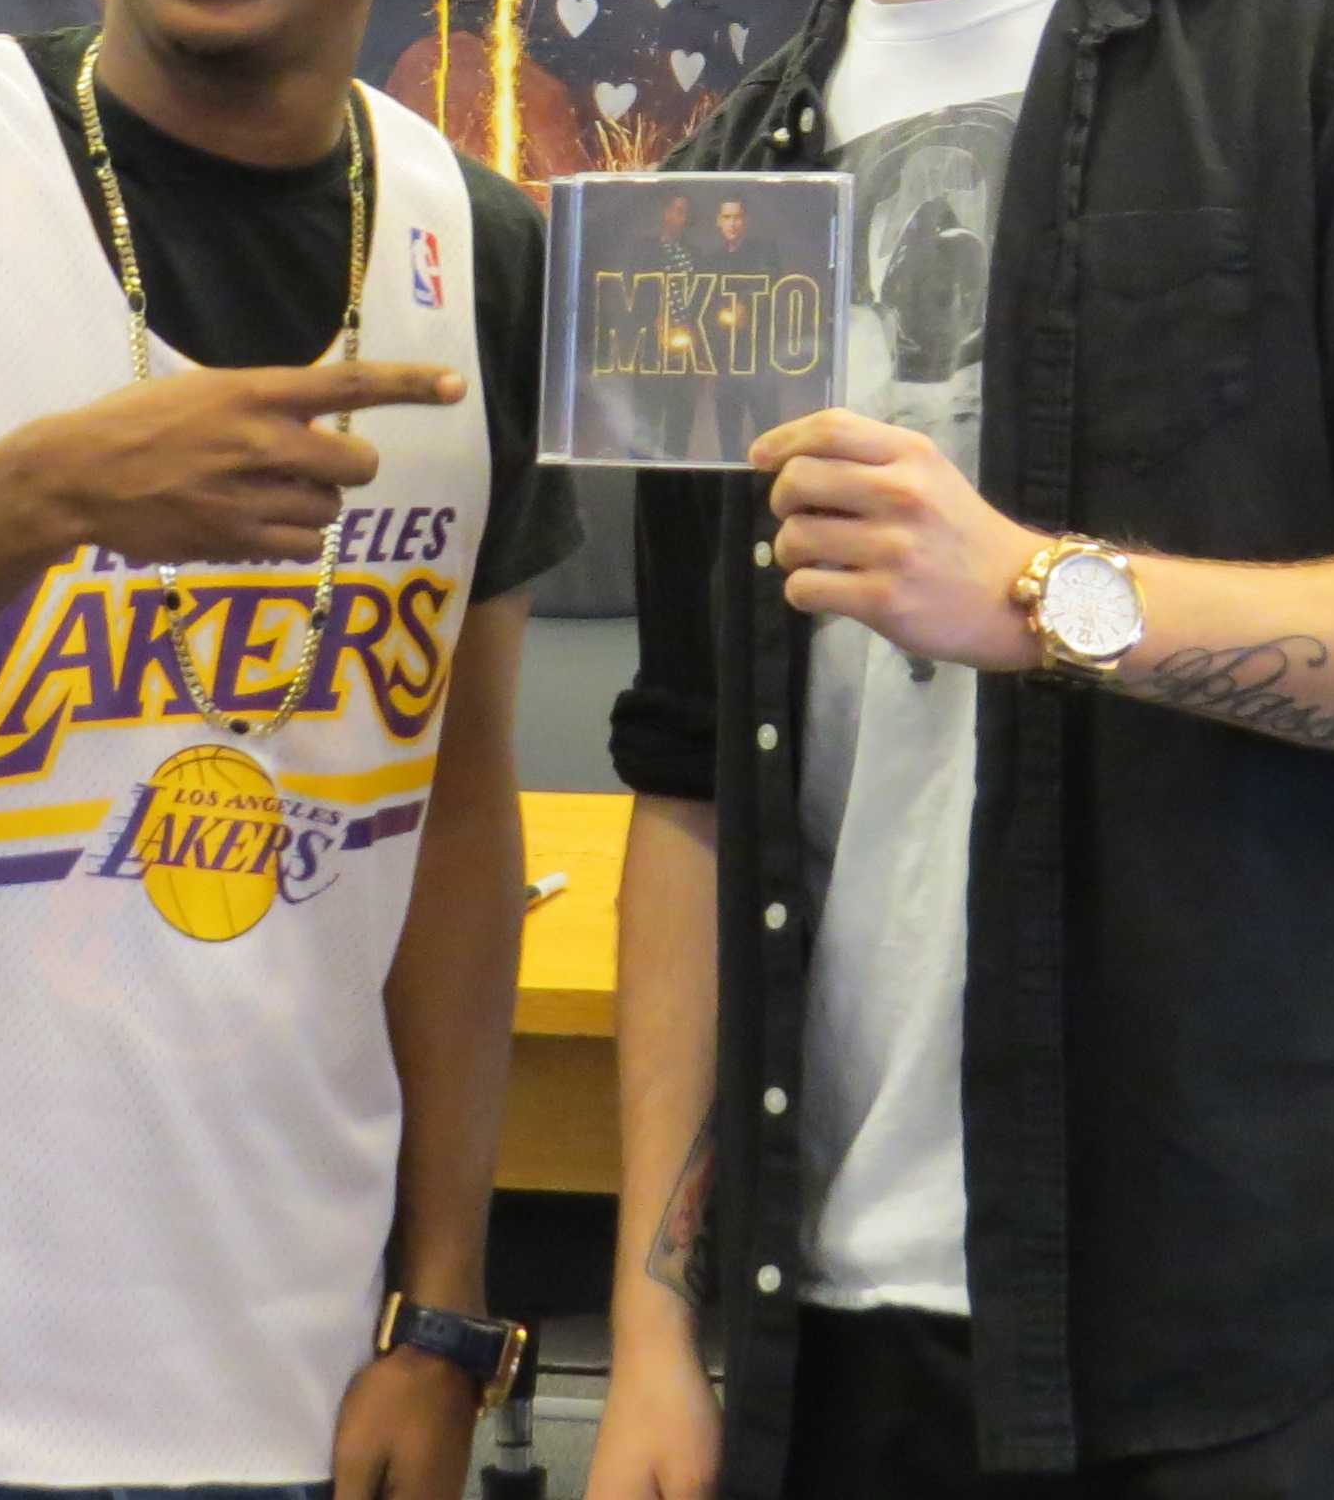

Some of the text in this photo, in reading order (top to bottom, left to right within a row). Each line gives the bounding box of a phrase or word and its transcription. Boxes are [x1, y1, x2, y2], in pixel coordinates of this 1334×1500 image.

[592, 270, 820, 376] MKTO
[86, 782, 341, 905] LAKERS
[173, 787, 344, 826] LOS ANGELES
